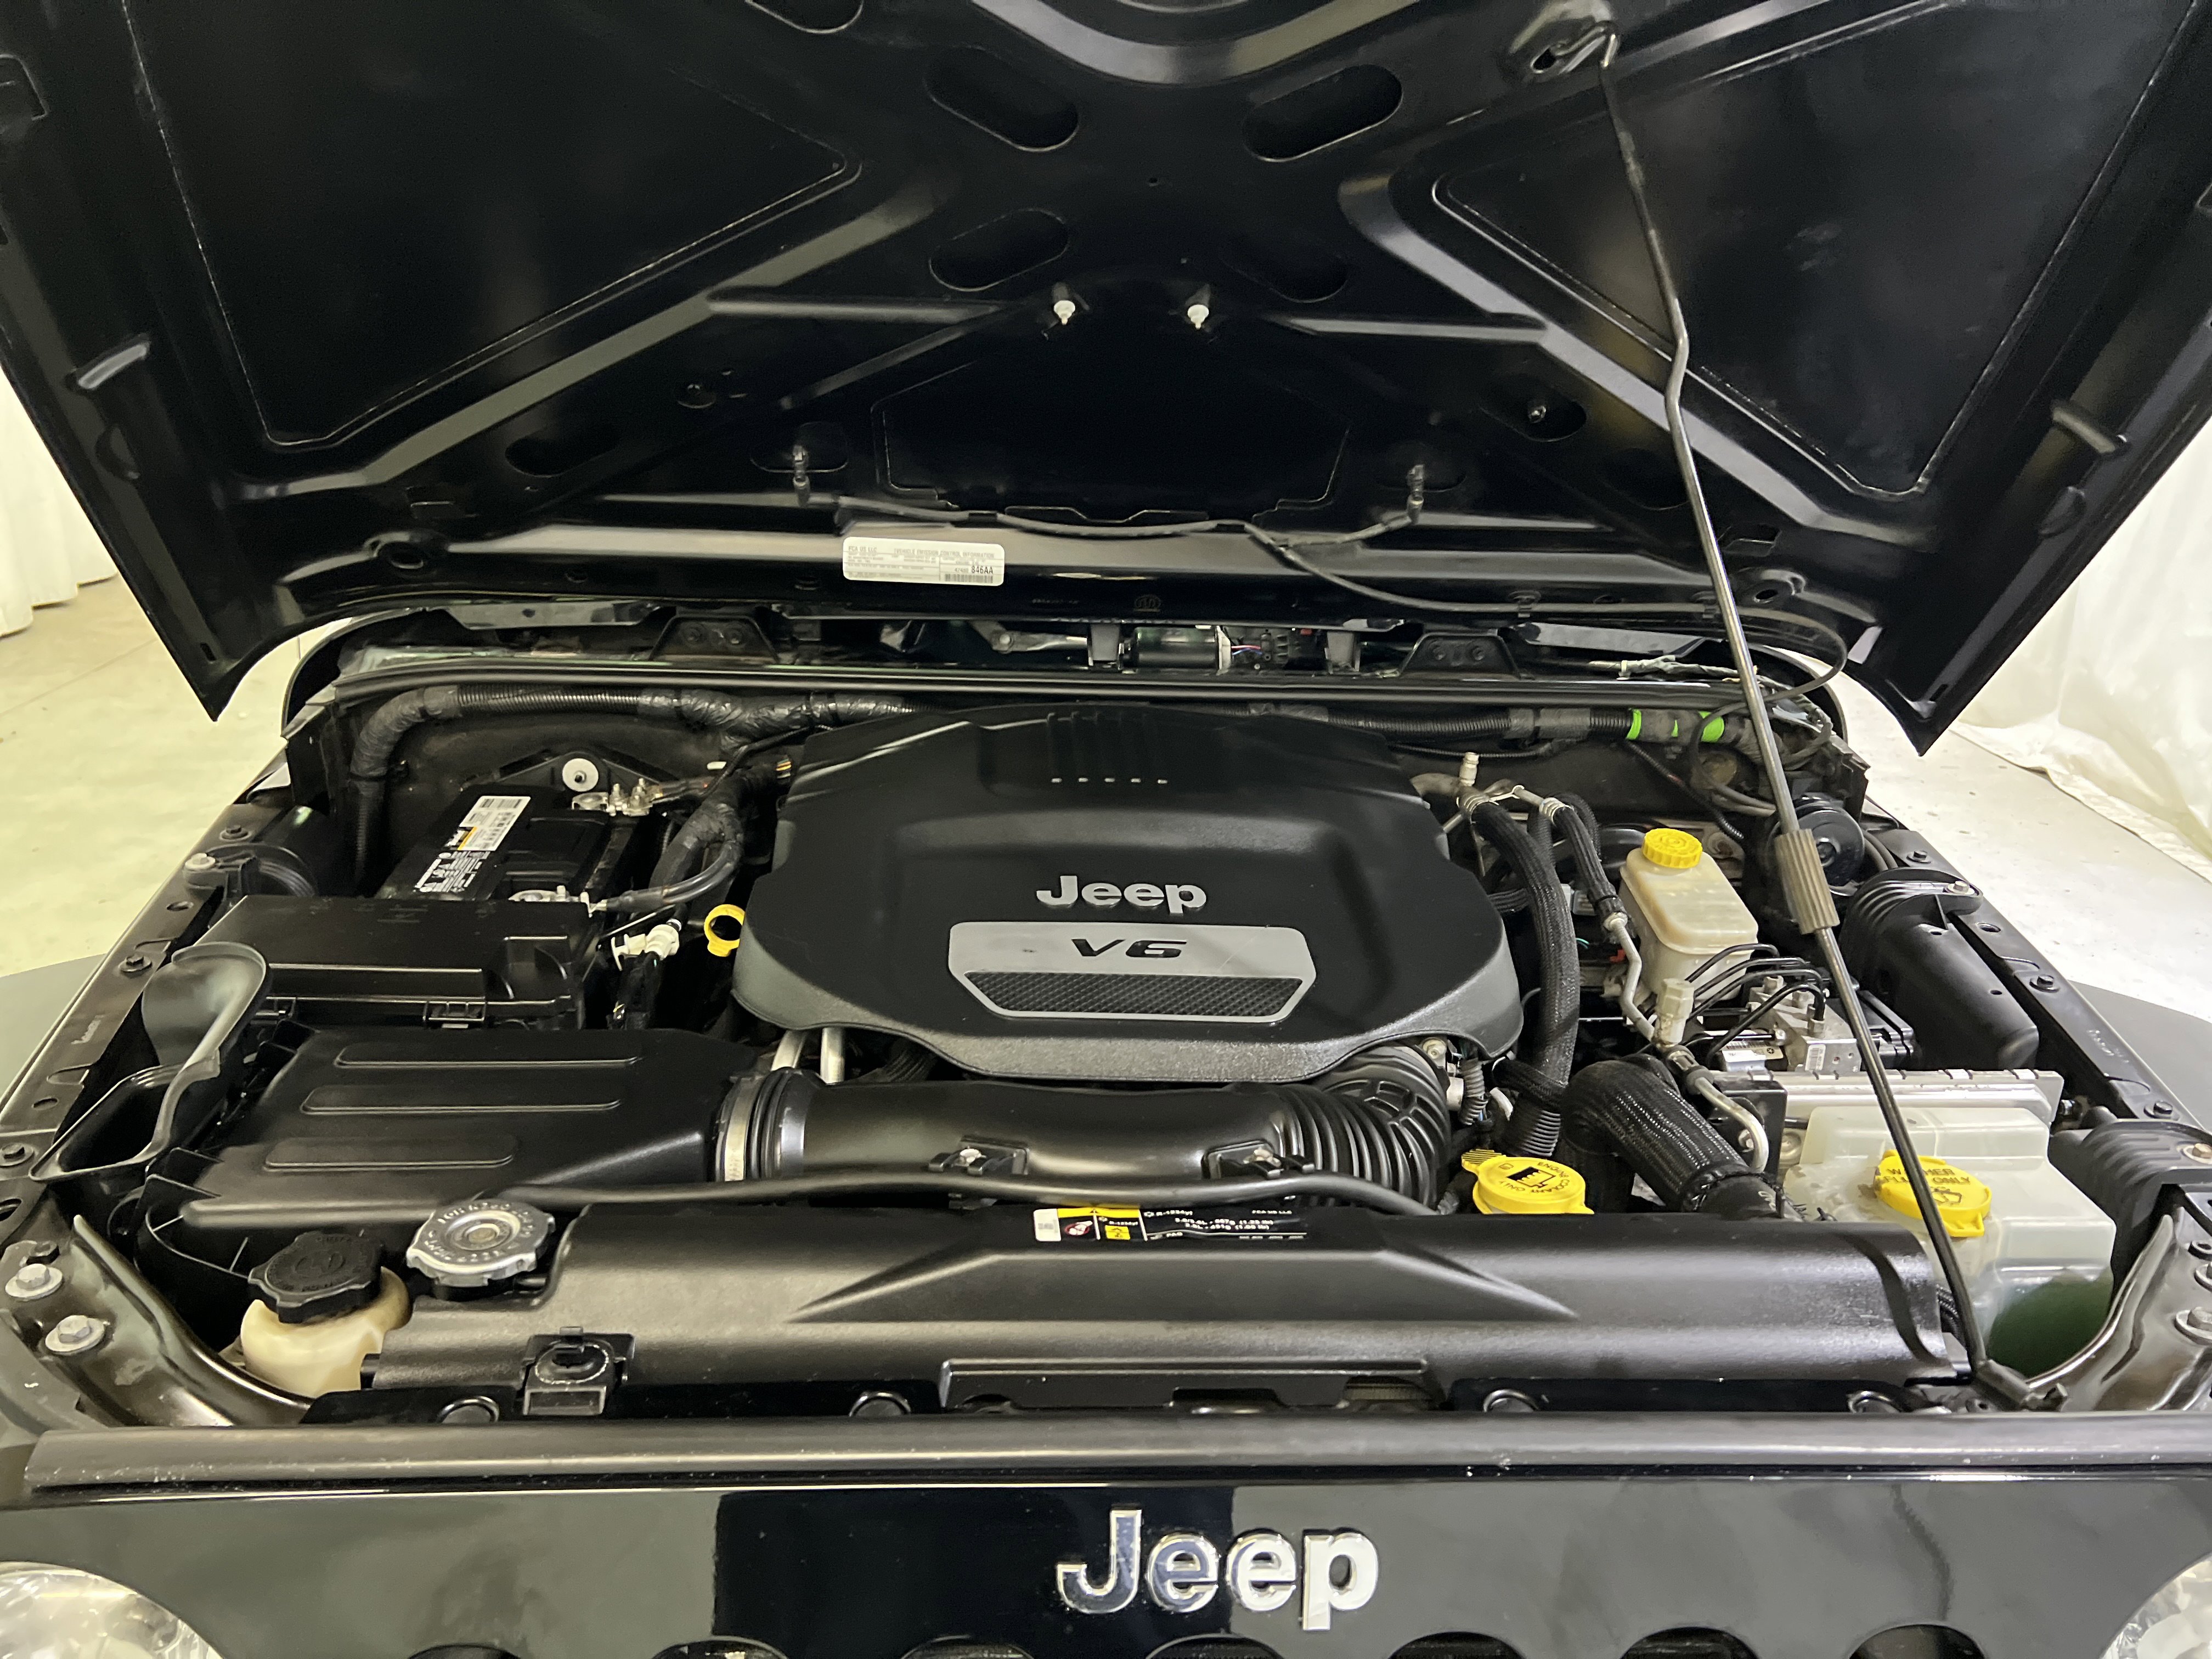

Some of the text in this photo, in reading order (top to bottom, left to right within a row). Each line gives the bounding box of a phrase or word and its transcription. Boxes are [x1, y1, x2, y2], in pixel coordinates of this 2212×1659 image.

[971, 565, 994, 574] 846AA
[1036, 876, 1207, 915] Jeep
[1070, 938, 1187, 958] V6
[1887, 1168, 1955, 1176] WHER
[1932, 1177, 1971, 1186] ONLY
[1056, 1509, 1379, 1631] Jeep
